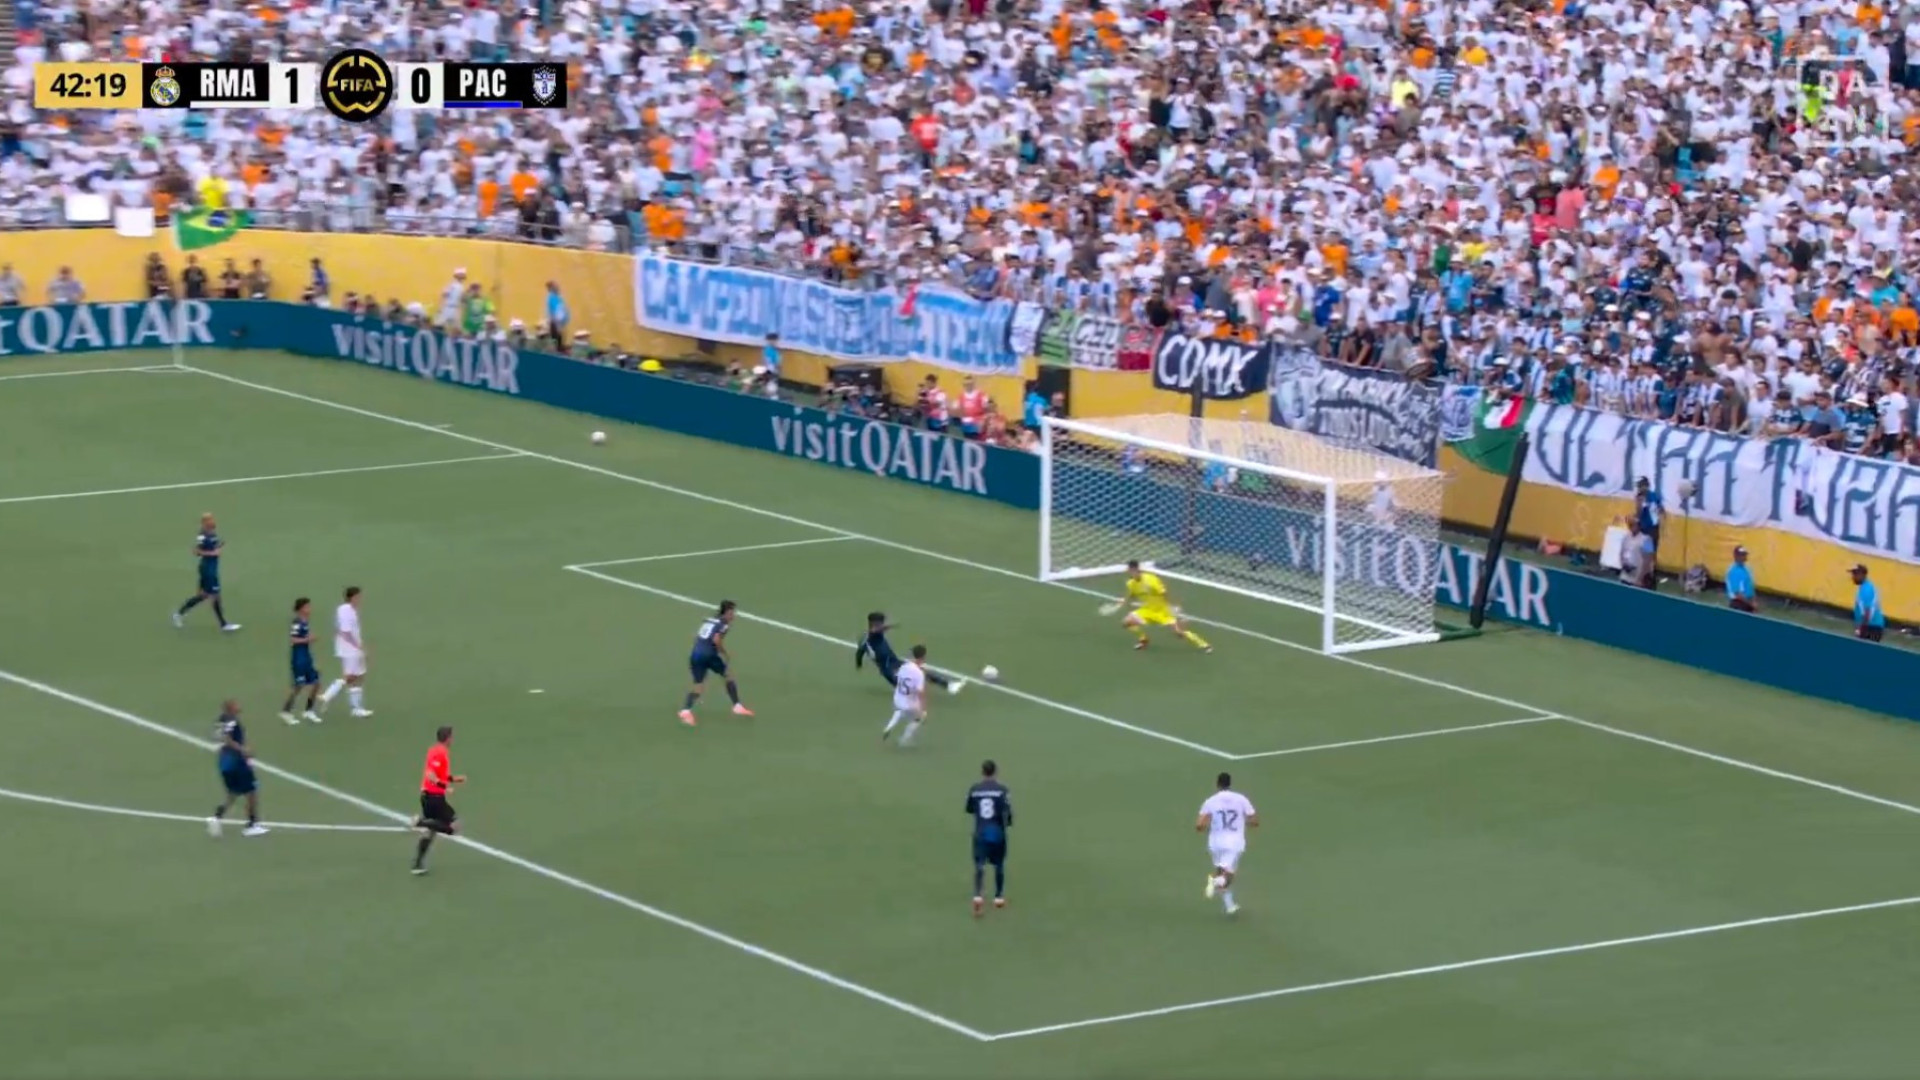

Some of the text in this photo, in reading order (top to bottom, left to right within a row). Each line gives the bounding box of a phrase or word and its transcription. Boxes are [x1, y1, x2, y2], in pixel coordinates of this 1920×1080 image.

[1157, 333, 1259, 396] CDMX
[980, 798, 995, 819] 8
[1216, 809, 1238, 831] 12
